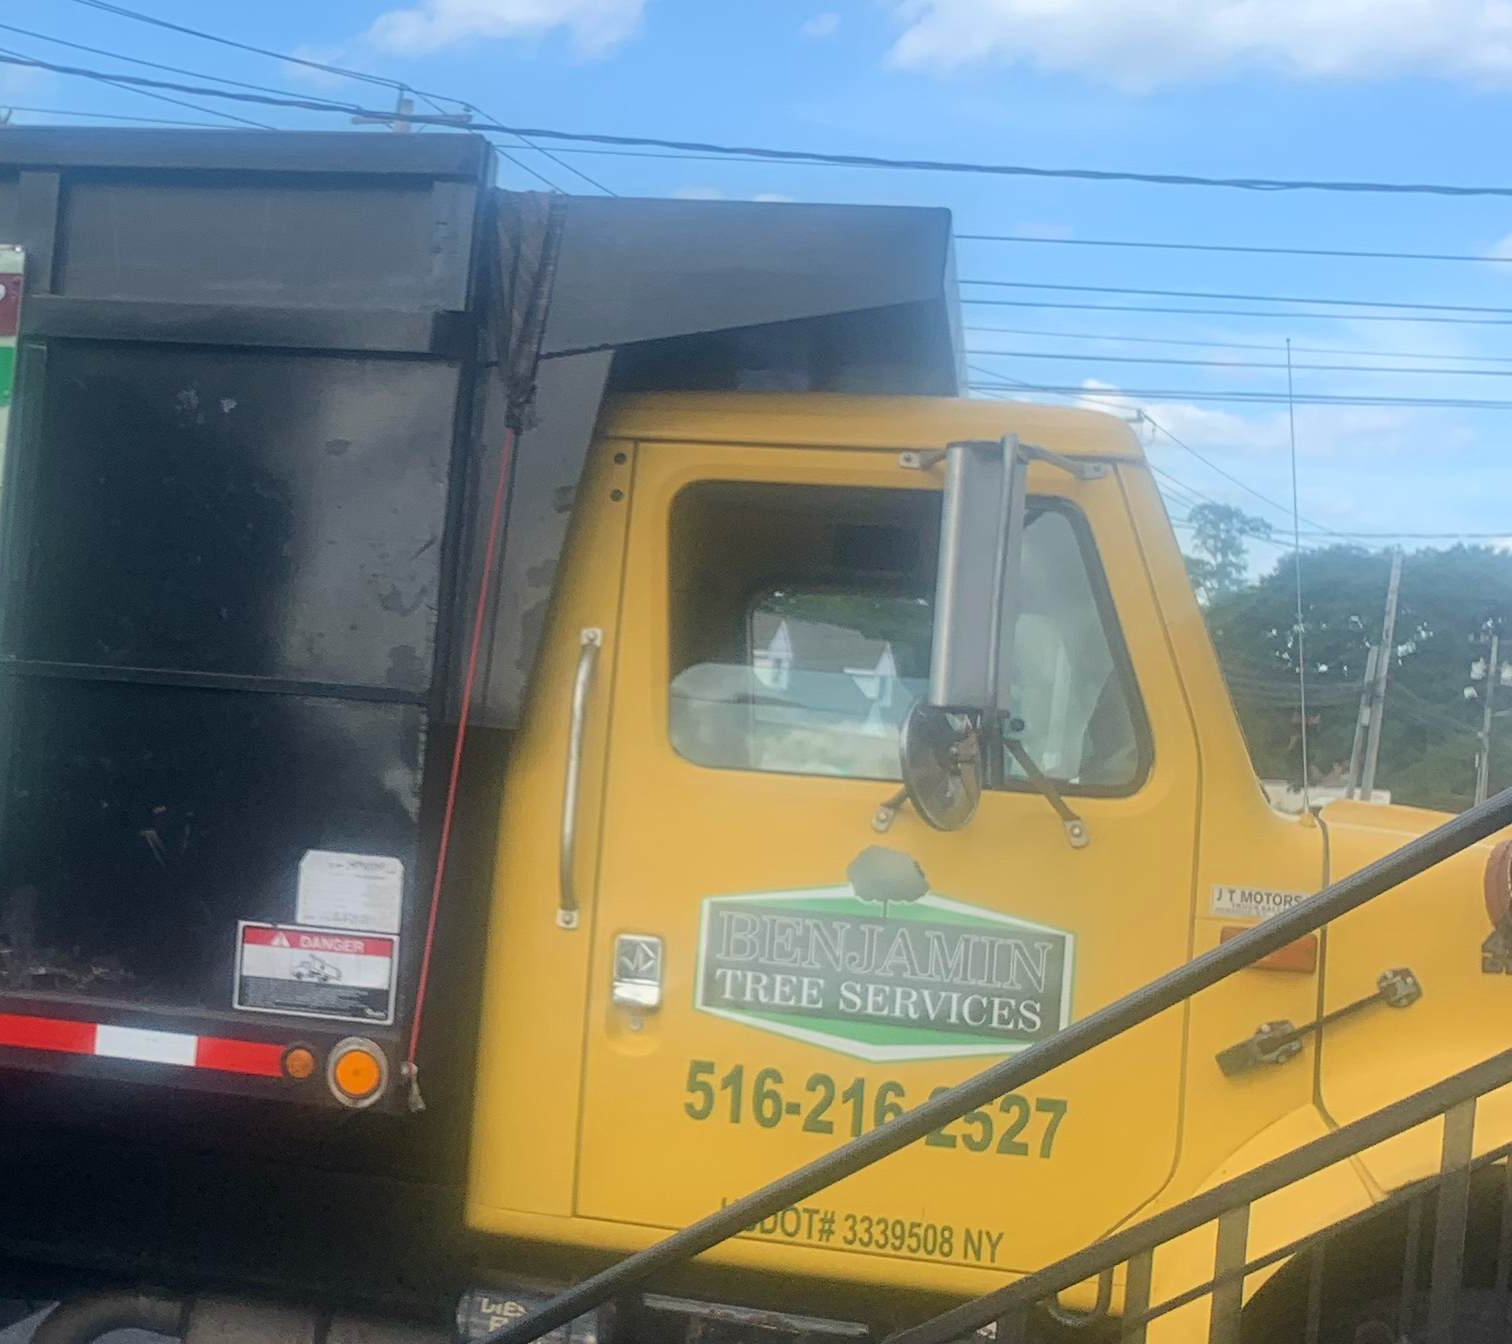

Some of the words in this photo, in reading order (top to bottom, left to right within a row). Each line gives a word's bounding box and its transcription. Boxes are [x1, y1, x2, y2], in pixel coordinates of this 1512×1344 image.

[299, 935, 365, 954] DANGER
[716, 909, 1052, 994] BENJAMIN
[715, 969, 825, 1010] TREE
[838, 980, 1043, 1033] SERVICES
[683, 1059, 1068, 1159] 516-2162527
[720, 1197, 835, 1242] DOT#
[842, 1213, 954, 1258] 3339508
[963, 1228, 1005, 1264] NY
